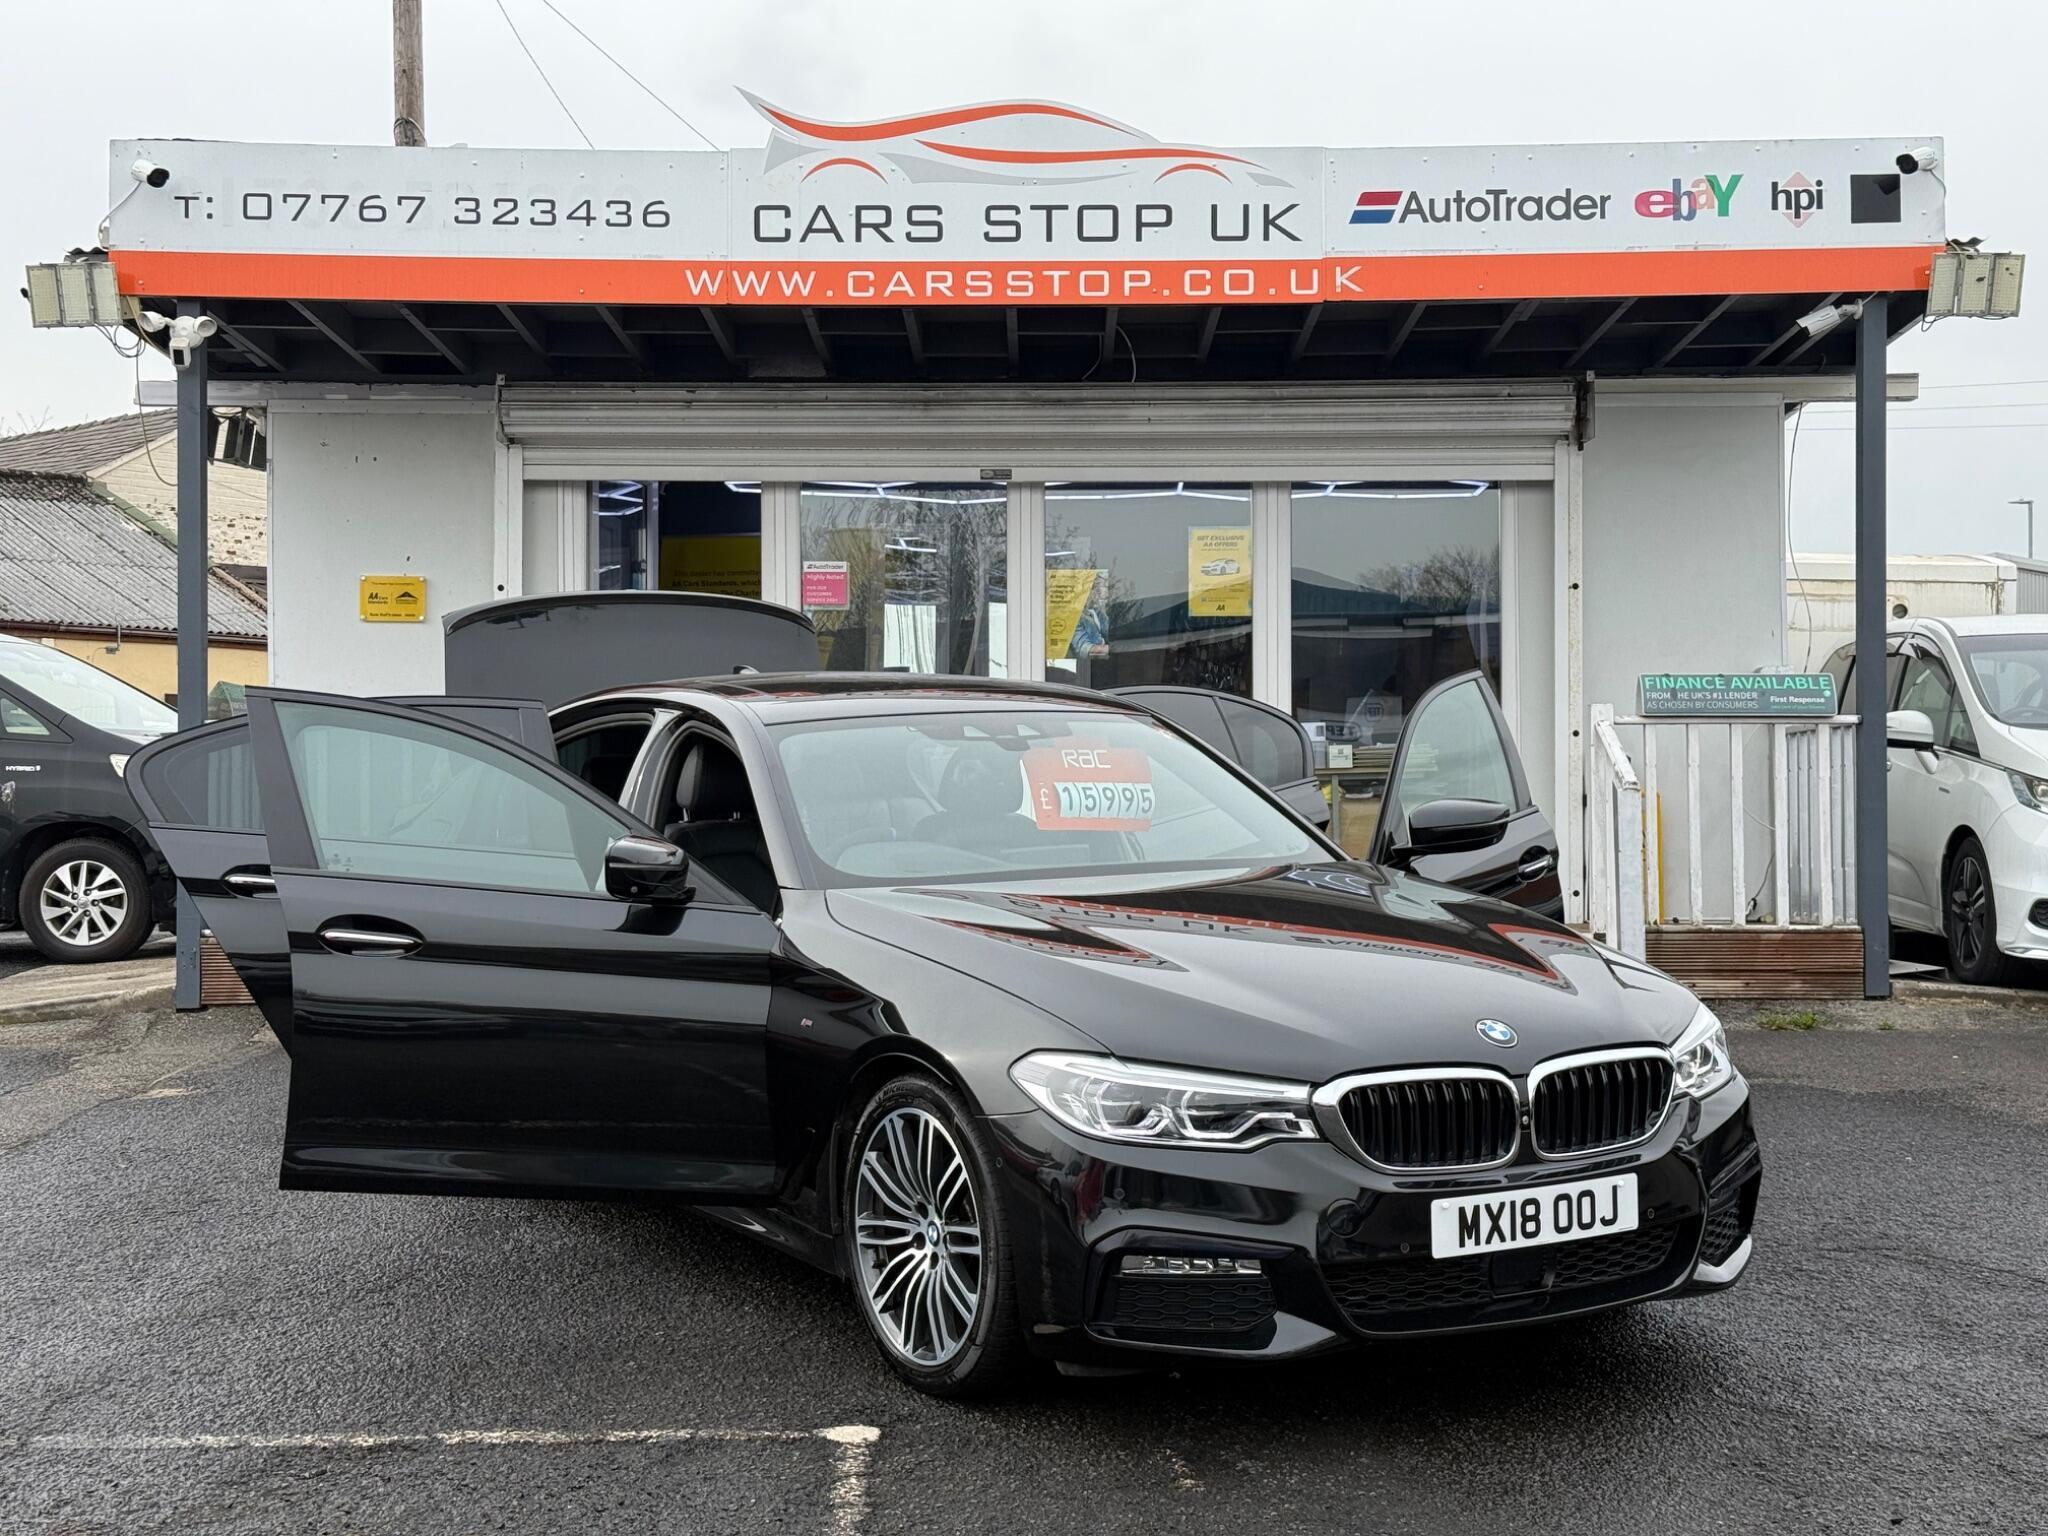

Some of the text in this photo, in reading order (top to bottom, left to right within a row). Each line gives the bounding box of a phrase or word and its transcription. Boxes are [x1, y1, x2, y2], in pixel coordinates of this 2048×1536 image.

[174, 192, 672, 228] T: 07767 323436
[1398, 186, 1611, 224] AutoTrader
[1771, 179, 1824, 219] hpi
[753, 203, 1303, 244] CARS STOP UK
[684, 265, 1365, 299] WWW.CARSSTOP.CO.UK
[1644, 676, 1832, 690] FINANCE AVAILABLE
[1646, 691, 1671, 700] FROM
[1724, 691, 1759, 700] LENDER
[1789, 696, 1826, 704] Response
[1646, 700, 1759, 709] AS CHOSEN BY CONSUMERS
[1062, 786, 1153, 815] 15995
[1458, 1197, 1542, 1249] MX18
